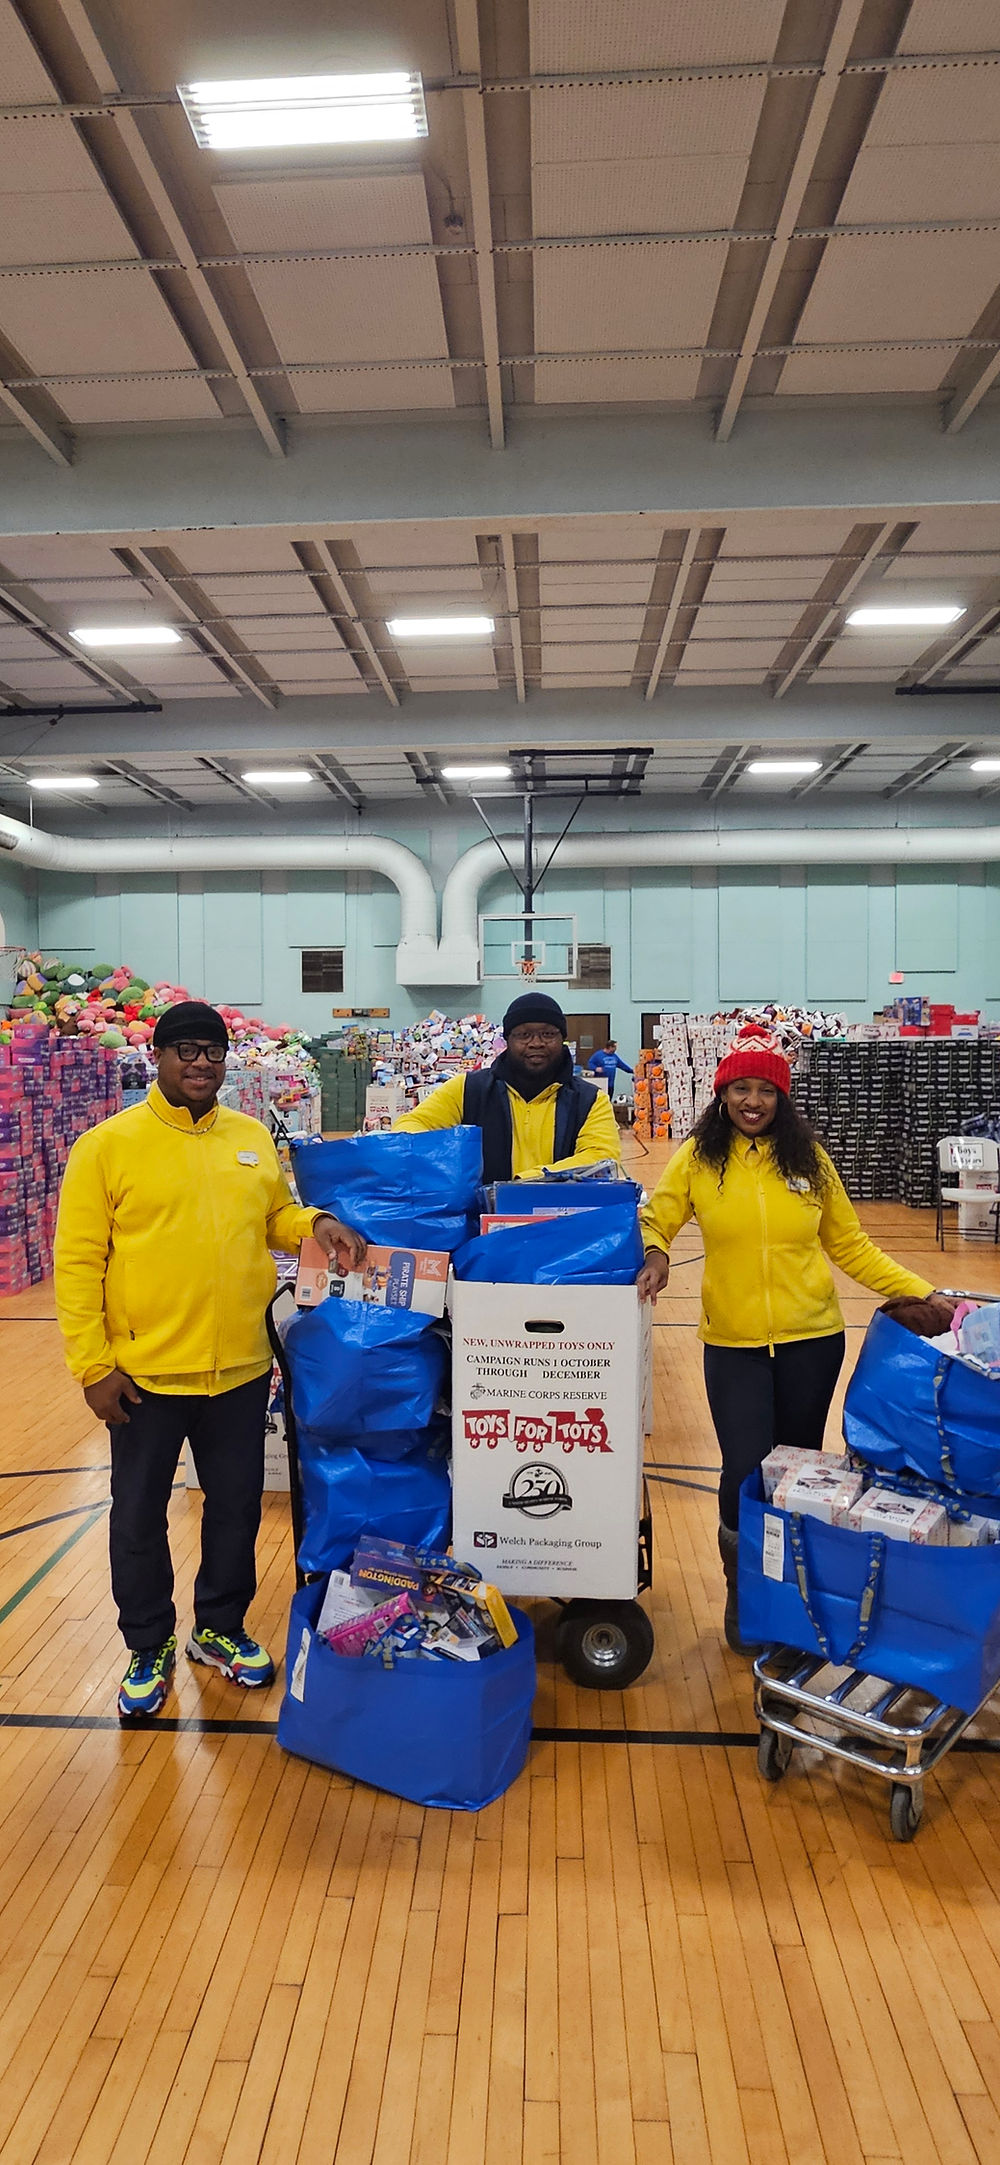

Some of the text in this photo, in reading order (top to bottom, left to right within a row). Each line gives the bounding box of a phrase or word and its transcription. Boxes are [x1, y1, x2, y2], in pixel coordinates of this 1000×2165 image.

[390, 1279, 400, 1305] PLAYSET
[397, 1262, 411, 1307] PIRATE SHIP
[490, 1339, 556, 1350] UNWRAPPED
[557, 1341, 585, 1351] TOYS
[586, 1341, 615, 1351] ONLY
[466, 1355, 611, 1368] CAMPAIGN RUNS 1 OCTOBER
[476, 1367, 601, 1379] THROUGH DECEMBER
[486, 1389, 607, 1400] MARINE CORPS RESERVE
[465, 1413, 602, 1443] TOYS FOR TOTS
[521, 1479, 561, 1499] 250
[499, 1536, 602, 1550] Welch Packaging Group
[358, 1569, 419, 1591] PADDINGTON
